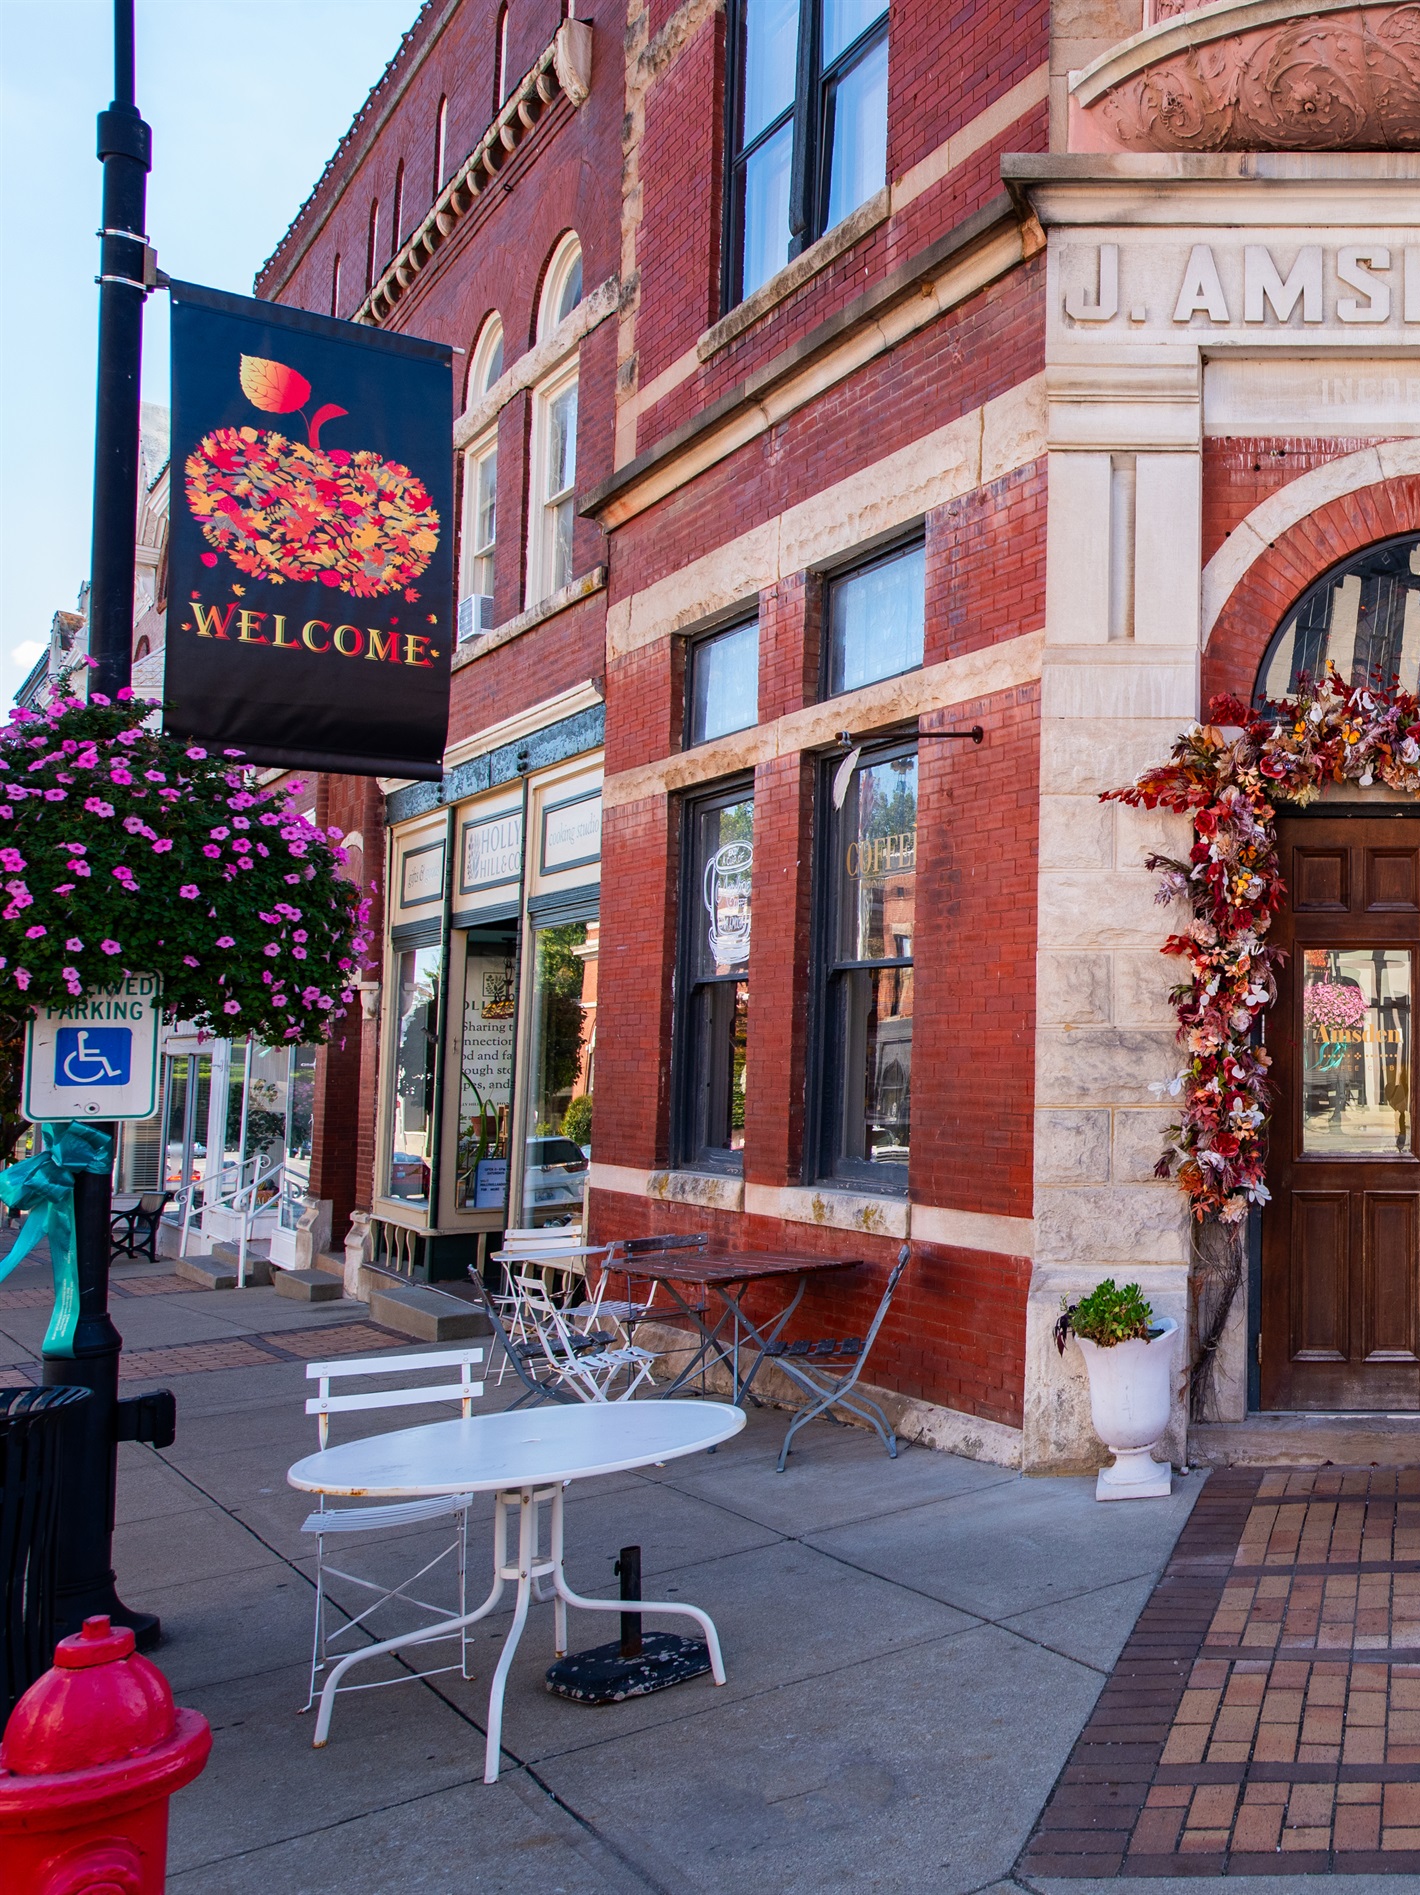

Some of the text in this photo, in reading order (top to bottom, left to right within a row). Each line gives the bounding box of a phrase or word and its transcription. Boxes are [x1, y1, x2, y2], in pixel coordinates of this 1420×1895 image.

[1065, 243, 1147, 323] J.
[188, 601, 434, 669] WELCOME
[481, 820, 522, 855] HOLLY
[548, 812, 600, 847] cooking studio
[47, 1001, 142, 1020] PARKING
[463, 1021, 506, 1034] Sharing
[1314, 1023, 1402, 1045] Amsden
[477, 1050, 499, 1061] and
